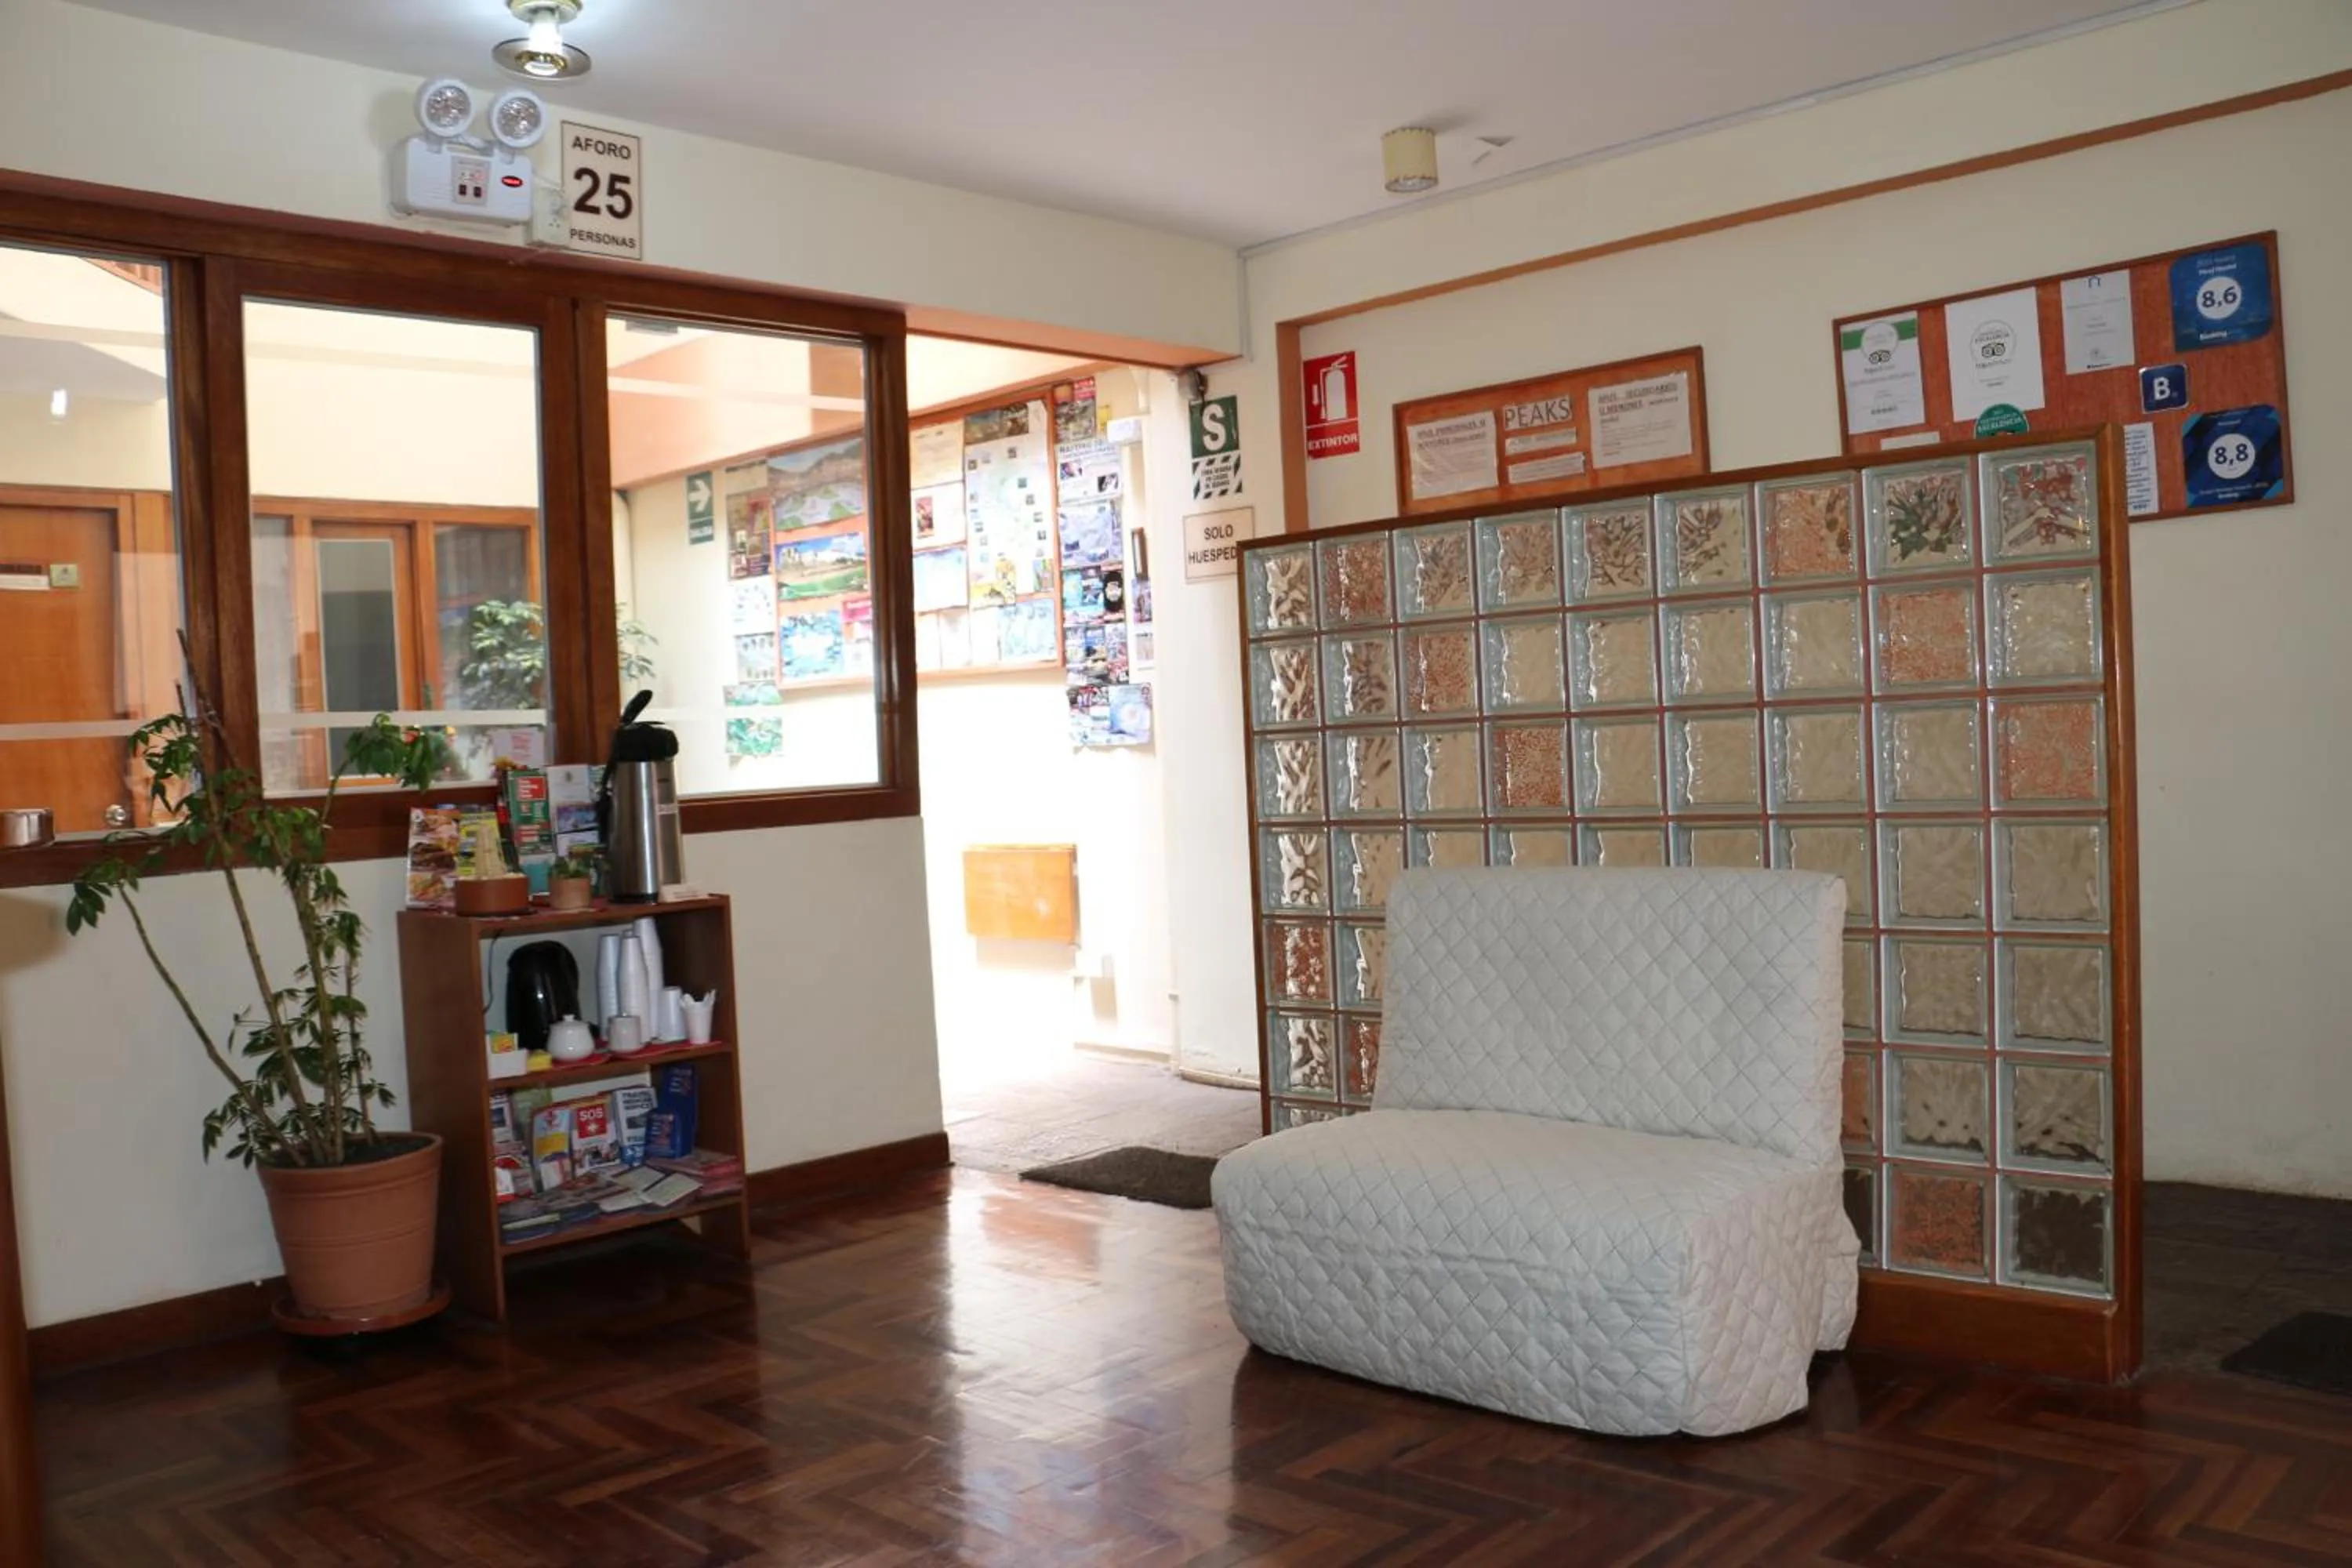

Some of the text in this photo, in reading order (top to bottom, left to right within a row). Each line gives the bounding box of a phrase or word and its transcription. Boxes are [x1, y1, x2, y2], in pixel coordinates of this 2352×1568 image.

[572, 136, 631, 159] AFORO
[573, 167, 633, 220] 25
[570, 228, 637, 249] PERSONAS
[2202, 285, 2238, 308] 8,6
[1505, 398, 1570, 428] PEAKS
[1202, 404, 1226, 451] S
[1308, 433, 1357, 451] EXTINTOR
[2215, 443, 2249, 466] 8,8
[1203, 524, 1234, 540] SOLO
[579, 1108, 603, 1121] SOS
